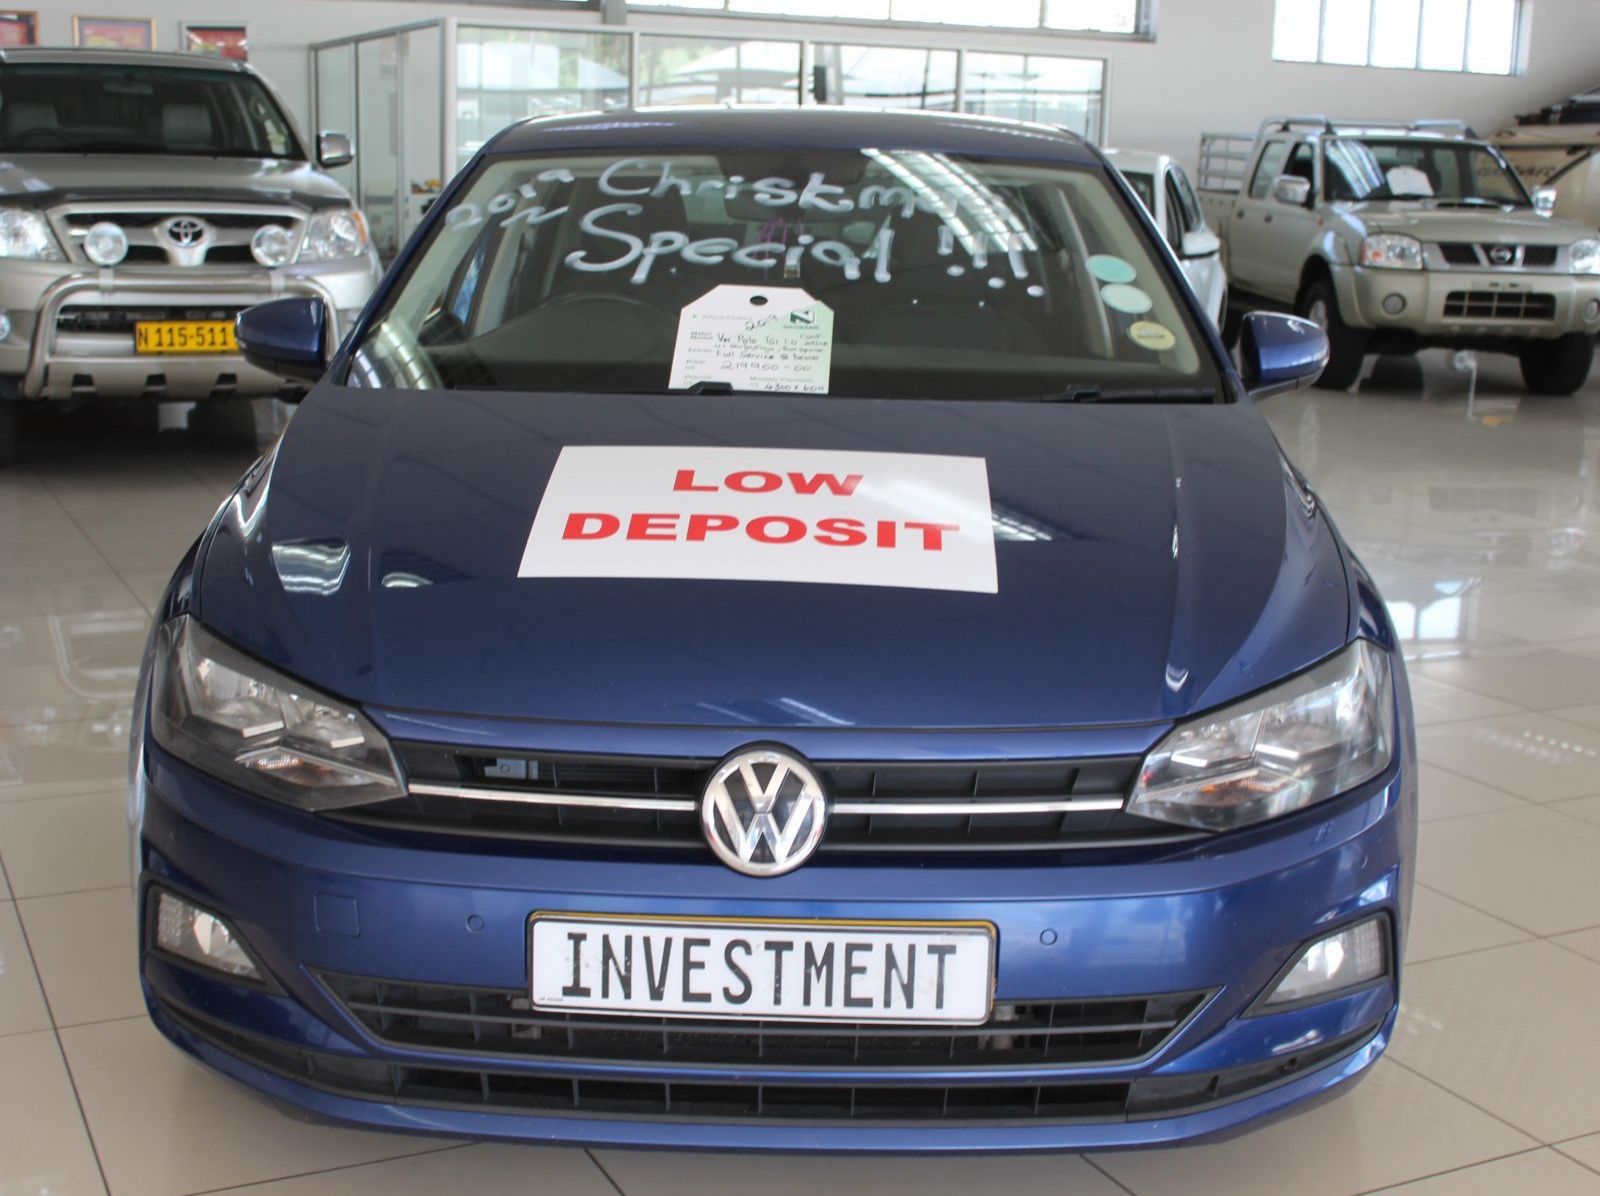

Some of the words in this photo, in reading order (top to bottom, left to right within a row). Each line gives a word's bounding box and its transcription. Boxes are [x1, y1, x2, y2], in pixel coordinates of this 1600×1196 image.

[598, 158, 1010, 219] Christma
[565, 203, 896, 284] Special
[137, 327, 148, 347] N
[155, 326, 228, 347] 115-511
[673, 469, 864, 496] LOW
[562, 513, 960, 552] DEPOSIT
[702, 750, 827, 876] VW
[561, 931, 958, 1010] INVESTMENT
